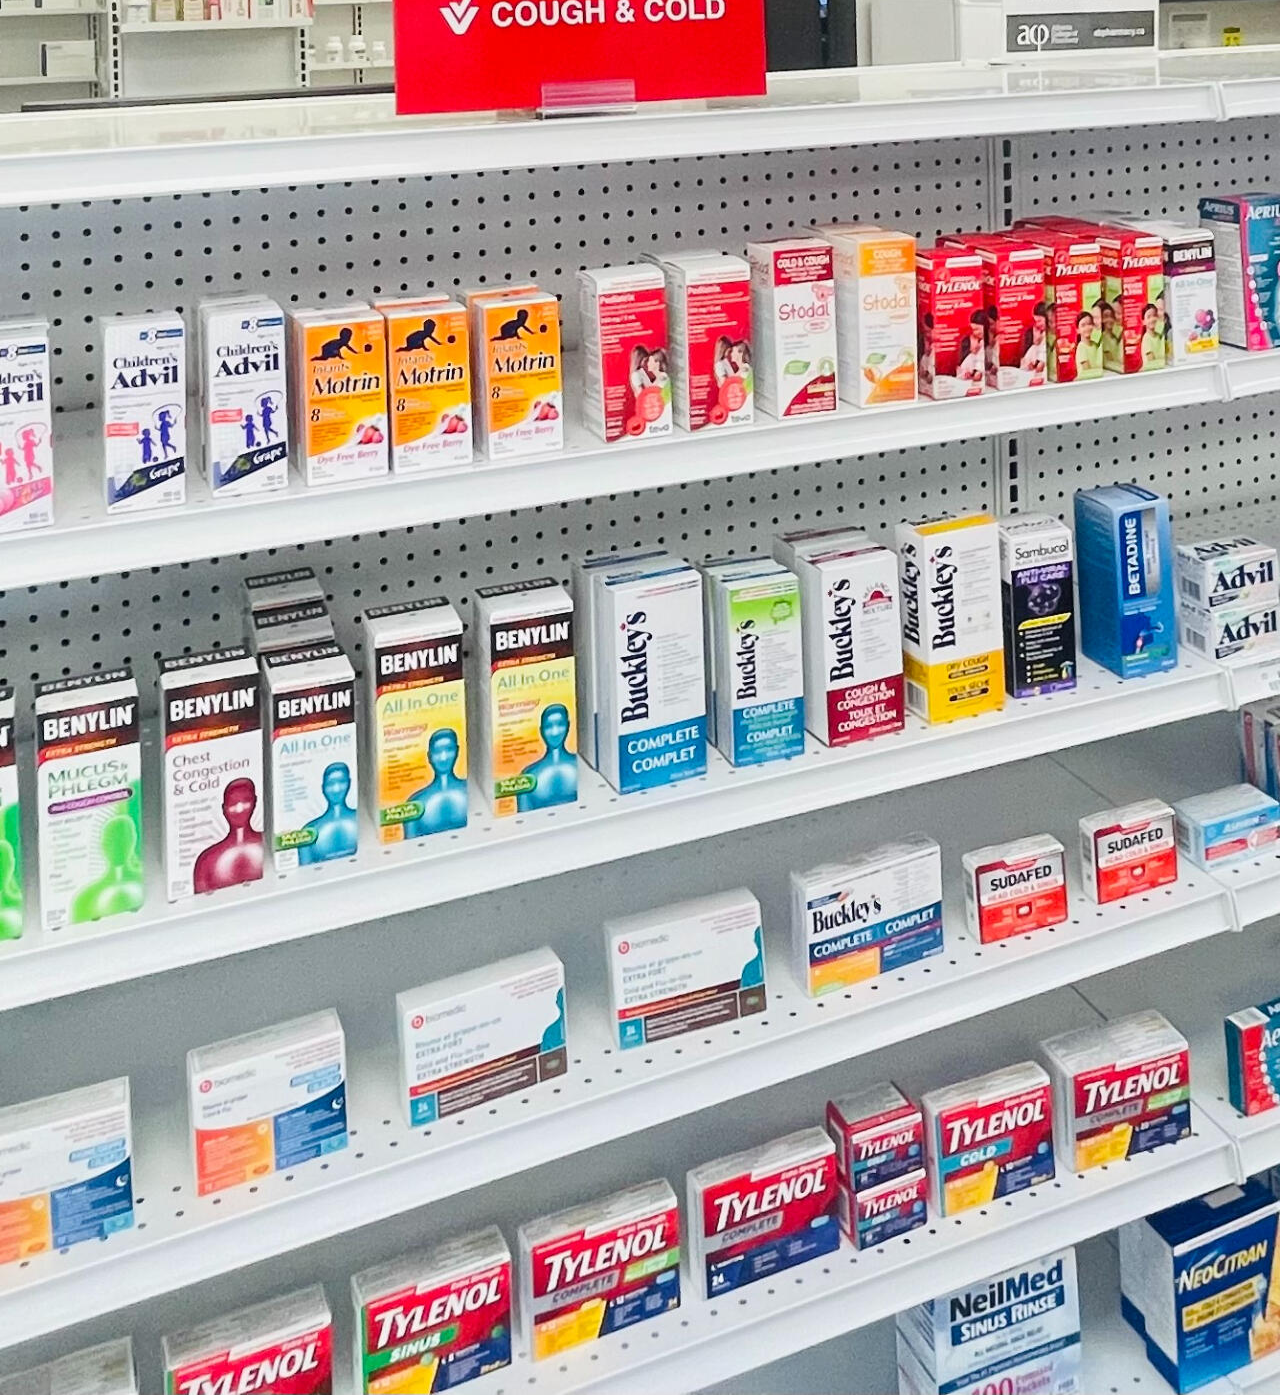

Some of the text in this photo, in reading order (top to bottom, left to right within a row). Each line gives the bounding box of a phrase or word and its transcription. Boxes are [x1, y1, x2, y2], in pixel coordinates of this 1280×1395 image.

[492, 0, 605, 28] COUGH
[615, 0, 635, 23] &
[1122, 256, 1162, 270] TYLENOL
[1173, 247, 1212, 263] BENYLIN
[998, 273, 1044, 287] TYLENOL
[1056, 263, 1099, 277] TYLENOL
[935, 280, 981, 295] TYLENOL
[779, 304, 830, 321] Stodal
[863, 295, 911, 312] Stodal
[214, 354, 280, 378] Advil
[397, 363, 464, 386] Motrin
[492, 353, 557, 375] Motrin
[111, 367, 179, 390] Advil
[311, 373, 381, 398] Motrin
[253, 445, 284, 465] Grape
[150, 463, 182, 481] Grape
[1015, 540, 1070, 561] Sambucol
[1128, 517, 1141, 595] BETADINE
[1193, 536, 1257, 557] Advil
[1212, 560, 1273, 594] Advil
[903, 542, 921, 647] Buckley's
[932, 546, 958, 651] Buckley's
[495, 621, 569, 651] BENYLIN
[827, 577, 856, 683] Buckley's
[1219, 611, 1277, 645] Advil
[380, 643, 459, 676] BENYLIN
[620, 610, 653, 724] Buckley's
[736, 619, 760, 701] Buckley's
[497, 666, 570, 690] All In One
[170, 687, 257, 722] BENYLIN
[278, 689, 353, 719] BENYLIN
[383, 690, 458, 714] All In One
[837, 689, 895, 710] CONGESTION
[845, 687, 878, 701] COUGH
[43, 704, 135, 740] BENYLIN
[743, 700, 796, 719] COMPLETE
[838, 710, 897, 732] CONGESTION
[848, 703, 886, 720] TOUX ET
[279, 732, 351, 756] All One
[627, 726, 700, 755] COMPLETE
[746, 725, 793, 743] COMPLET
[172, 751, 210, 767] Chest
[173, 756, 250, 782] Congestion
[632, 746, 696, 774] COMPLET
[47, 760, 117, 785] MUCUS
[49, 774, 128, 799] PHLEGM
[173, 777, 220, 796] & Cold
[1107, 827, 1163, 854] SUDAFED
[990, 865, 1052, 891] SUDAFED
[812, 894, 882, 934] Buckley's
[814, 908, 935, 957] COMPLETE COMPLET
[1083, 1063, 1181, 1114] TYLENOL
[946, 1099, 1045, 1153] TYLENOL
[1089, 1105, 1139, 1123] COMPLETE
[859, 1130, 915, 1160] TYLENOL
[960, 1145, 997, 1167] COLD
[713, 1168, 826, 1233] TYLENOL
[863, 1186, 919, 1219] TYLENOL
[722, 1215, 779, 1243] COMPLETE
[544, 1224, 666, 1293] TYLENOL
[552, 1272, 616, 1303] COMPLETE
[712, 1275, 724, 1286] 24
[950, 1259, 1063, 1322] NeilMed
[374, 1277, 501, 1350] TYLENOL
[960, 1294, 1057, 1342] SINUS RINSE
[389, 1333, 441, 1363] SINUS
[179, 1342, 318, 1395] TYLENOL
